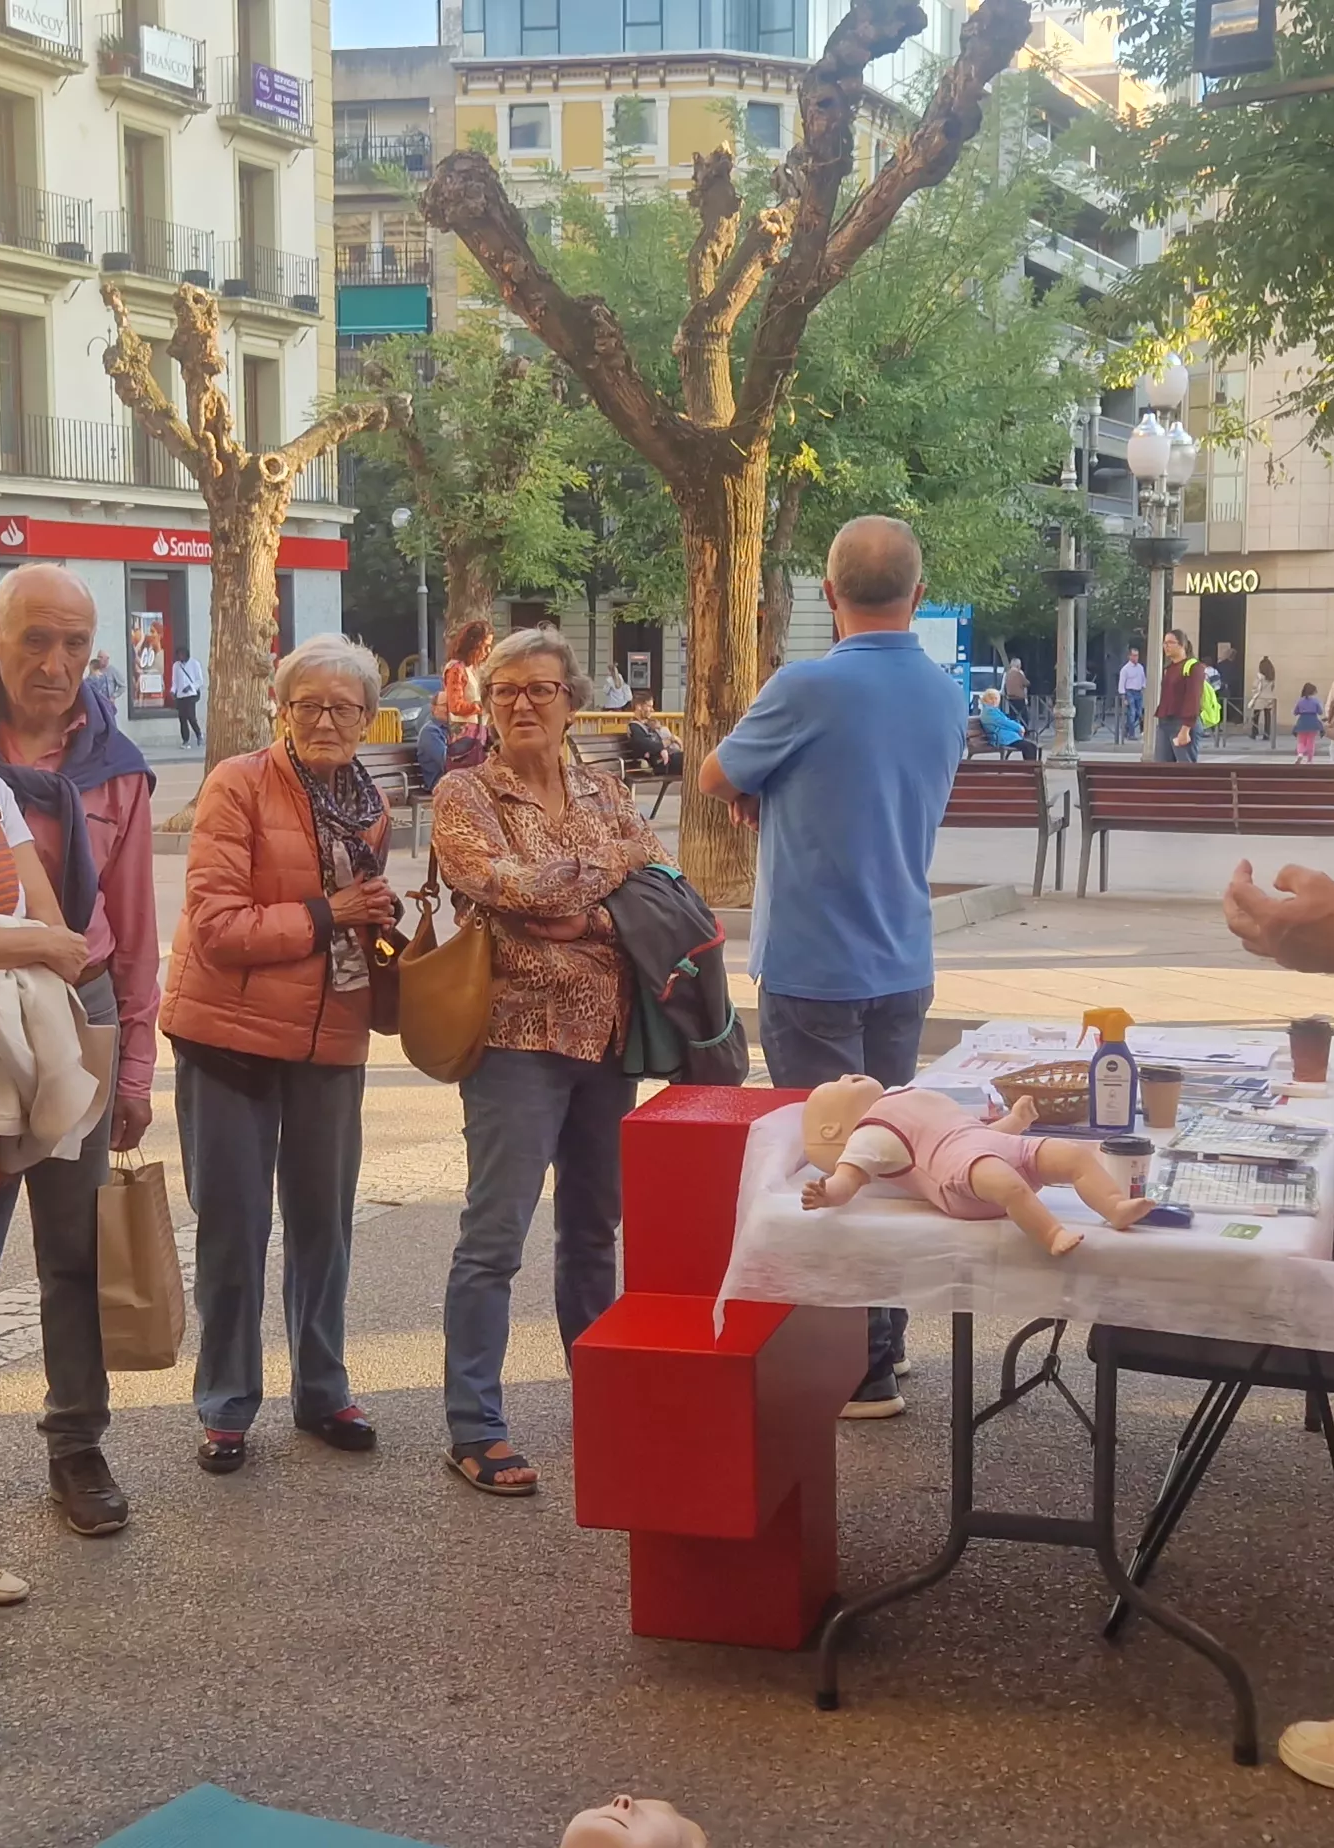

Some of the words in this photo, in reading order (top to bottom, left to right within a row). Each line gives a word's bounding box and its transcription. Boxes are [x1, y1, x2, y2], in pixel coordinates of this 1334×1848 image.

[12, 5, 64, 37] FRANCOY
[146, 51, 192, 82] FRANCOY
[170, 537, 211, 558] Santan
[1185, 569, 1259, 594] MANGO
